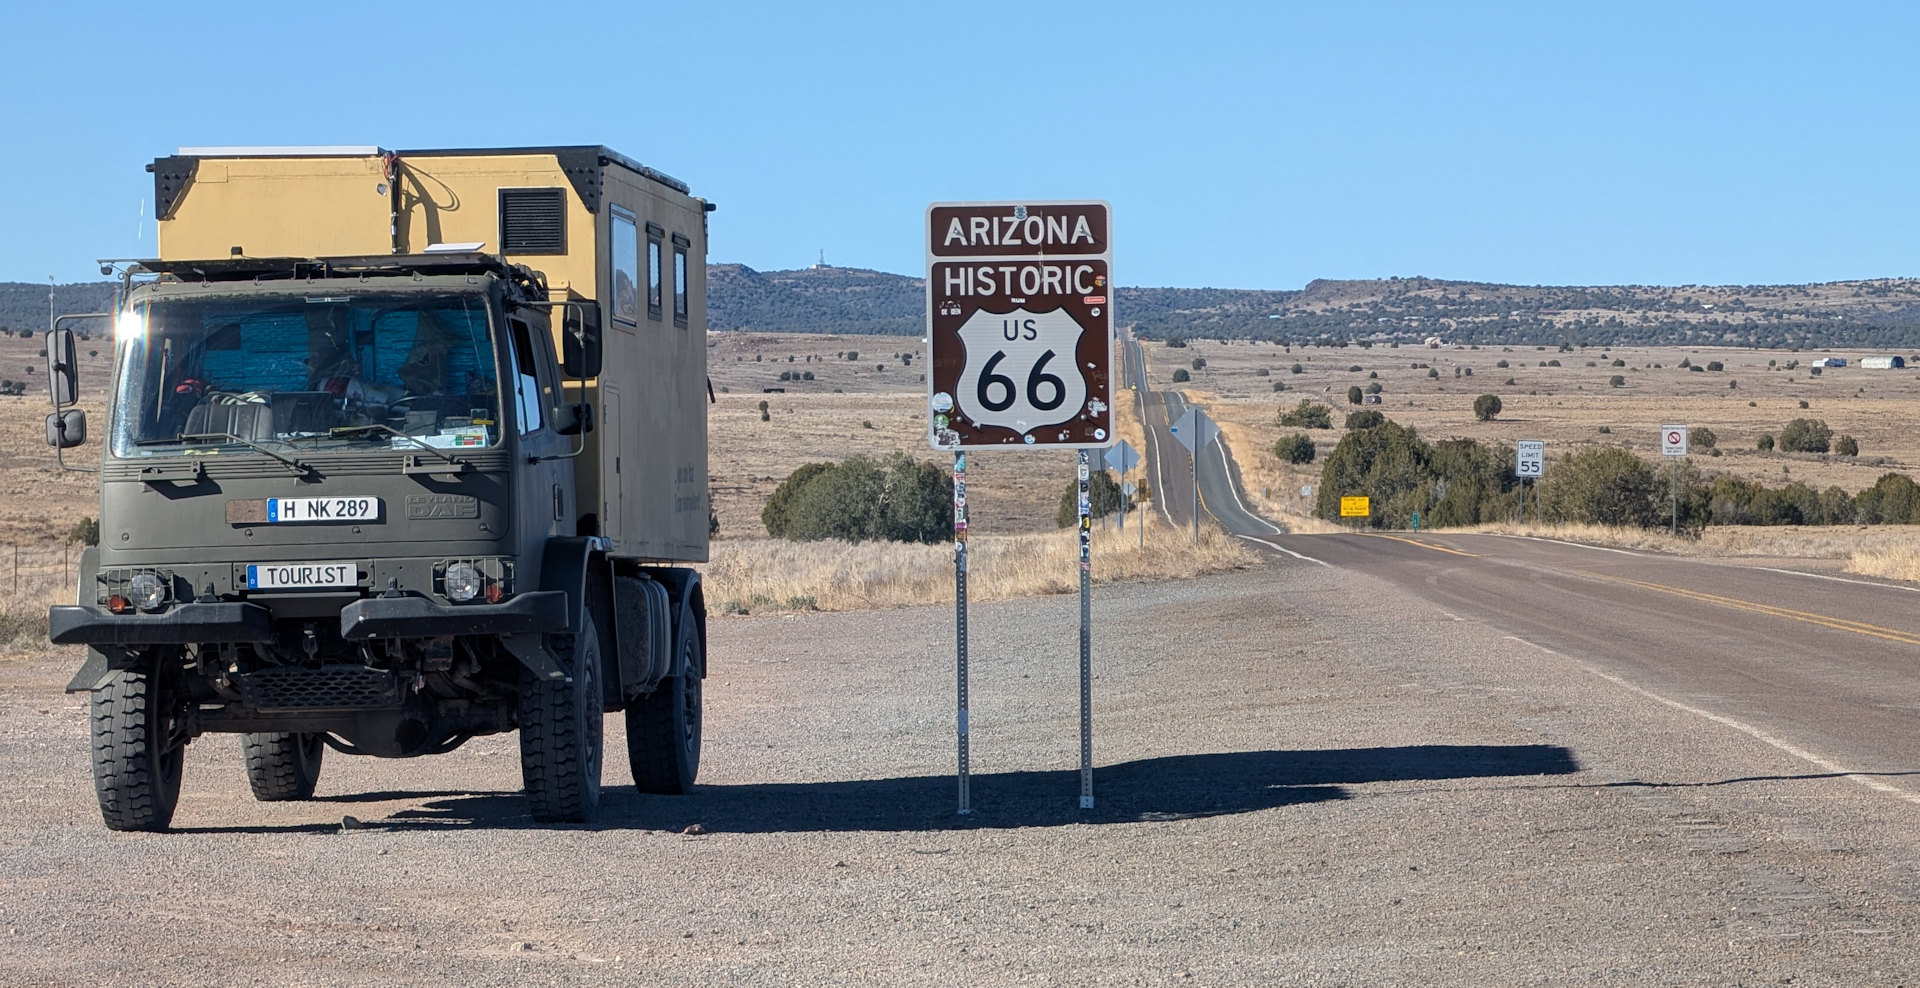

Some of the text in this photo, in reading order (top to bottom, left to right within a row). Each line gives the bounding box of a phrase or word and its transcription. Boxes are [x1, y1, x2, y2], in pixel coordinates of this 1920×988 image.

[944, 215, 1095, 246] ARIZONA
[945, 265, 1094, 296] HISTORIC
[1003, 319, 1037, 341] US
[977, 349, 1066, 412] 66
[1520, 461, 1540, 472] 55
[284, 501, 296, 518] H
[308, 500, 331, 518] NK
[336, 499, 369, 517] 289
[408, 503, 476, 517] DAF
[267, 566, 347, 585] TOURIST
